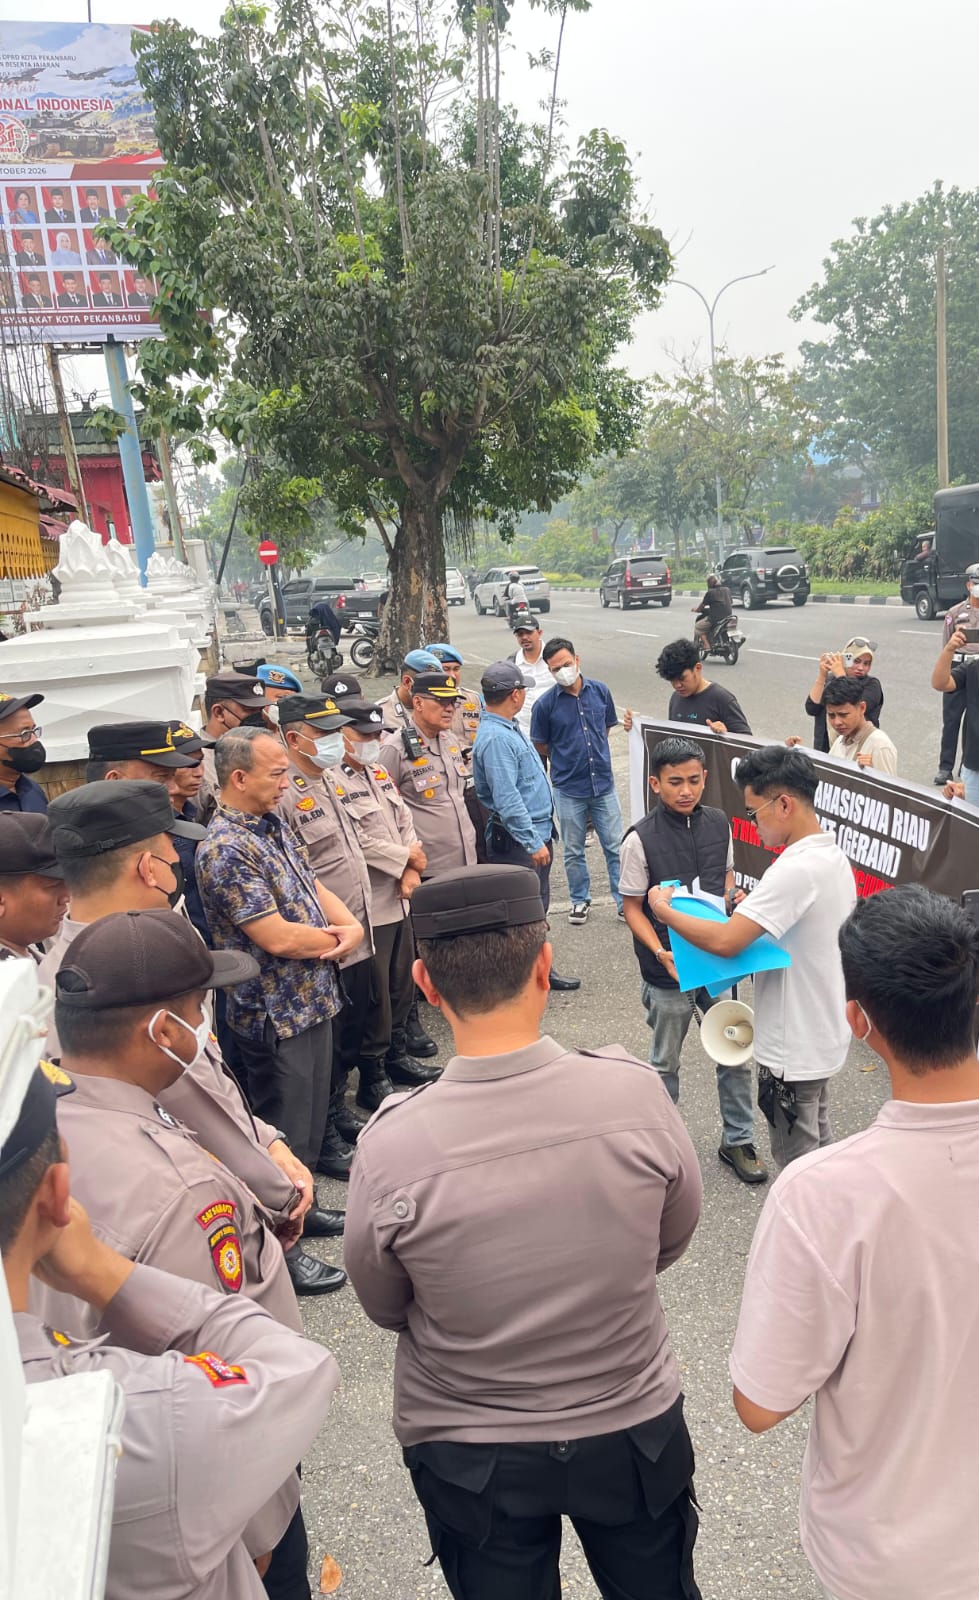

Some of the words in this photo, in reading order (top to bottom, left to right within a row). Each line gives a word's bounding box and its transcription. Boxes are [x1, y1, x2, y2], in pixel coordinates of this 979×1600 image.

[0, 98, 34, 111] NAL
[36, 98, 114, 111] INDONESIA
[27, 167, 47, 175] 2026
[55, 315, 81, 324] KOTA
[83, 314, 141, 323] PEKANBARU
[890, 807, 931, 852] RIAU
